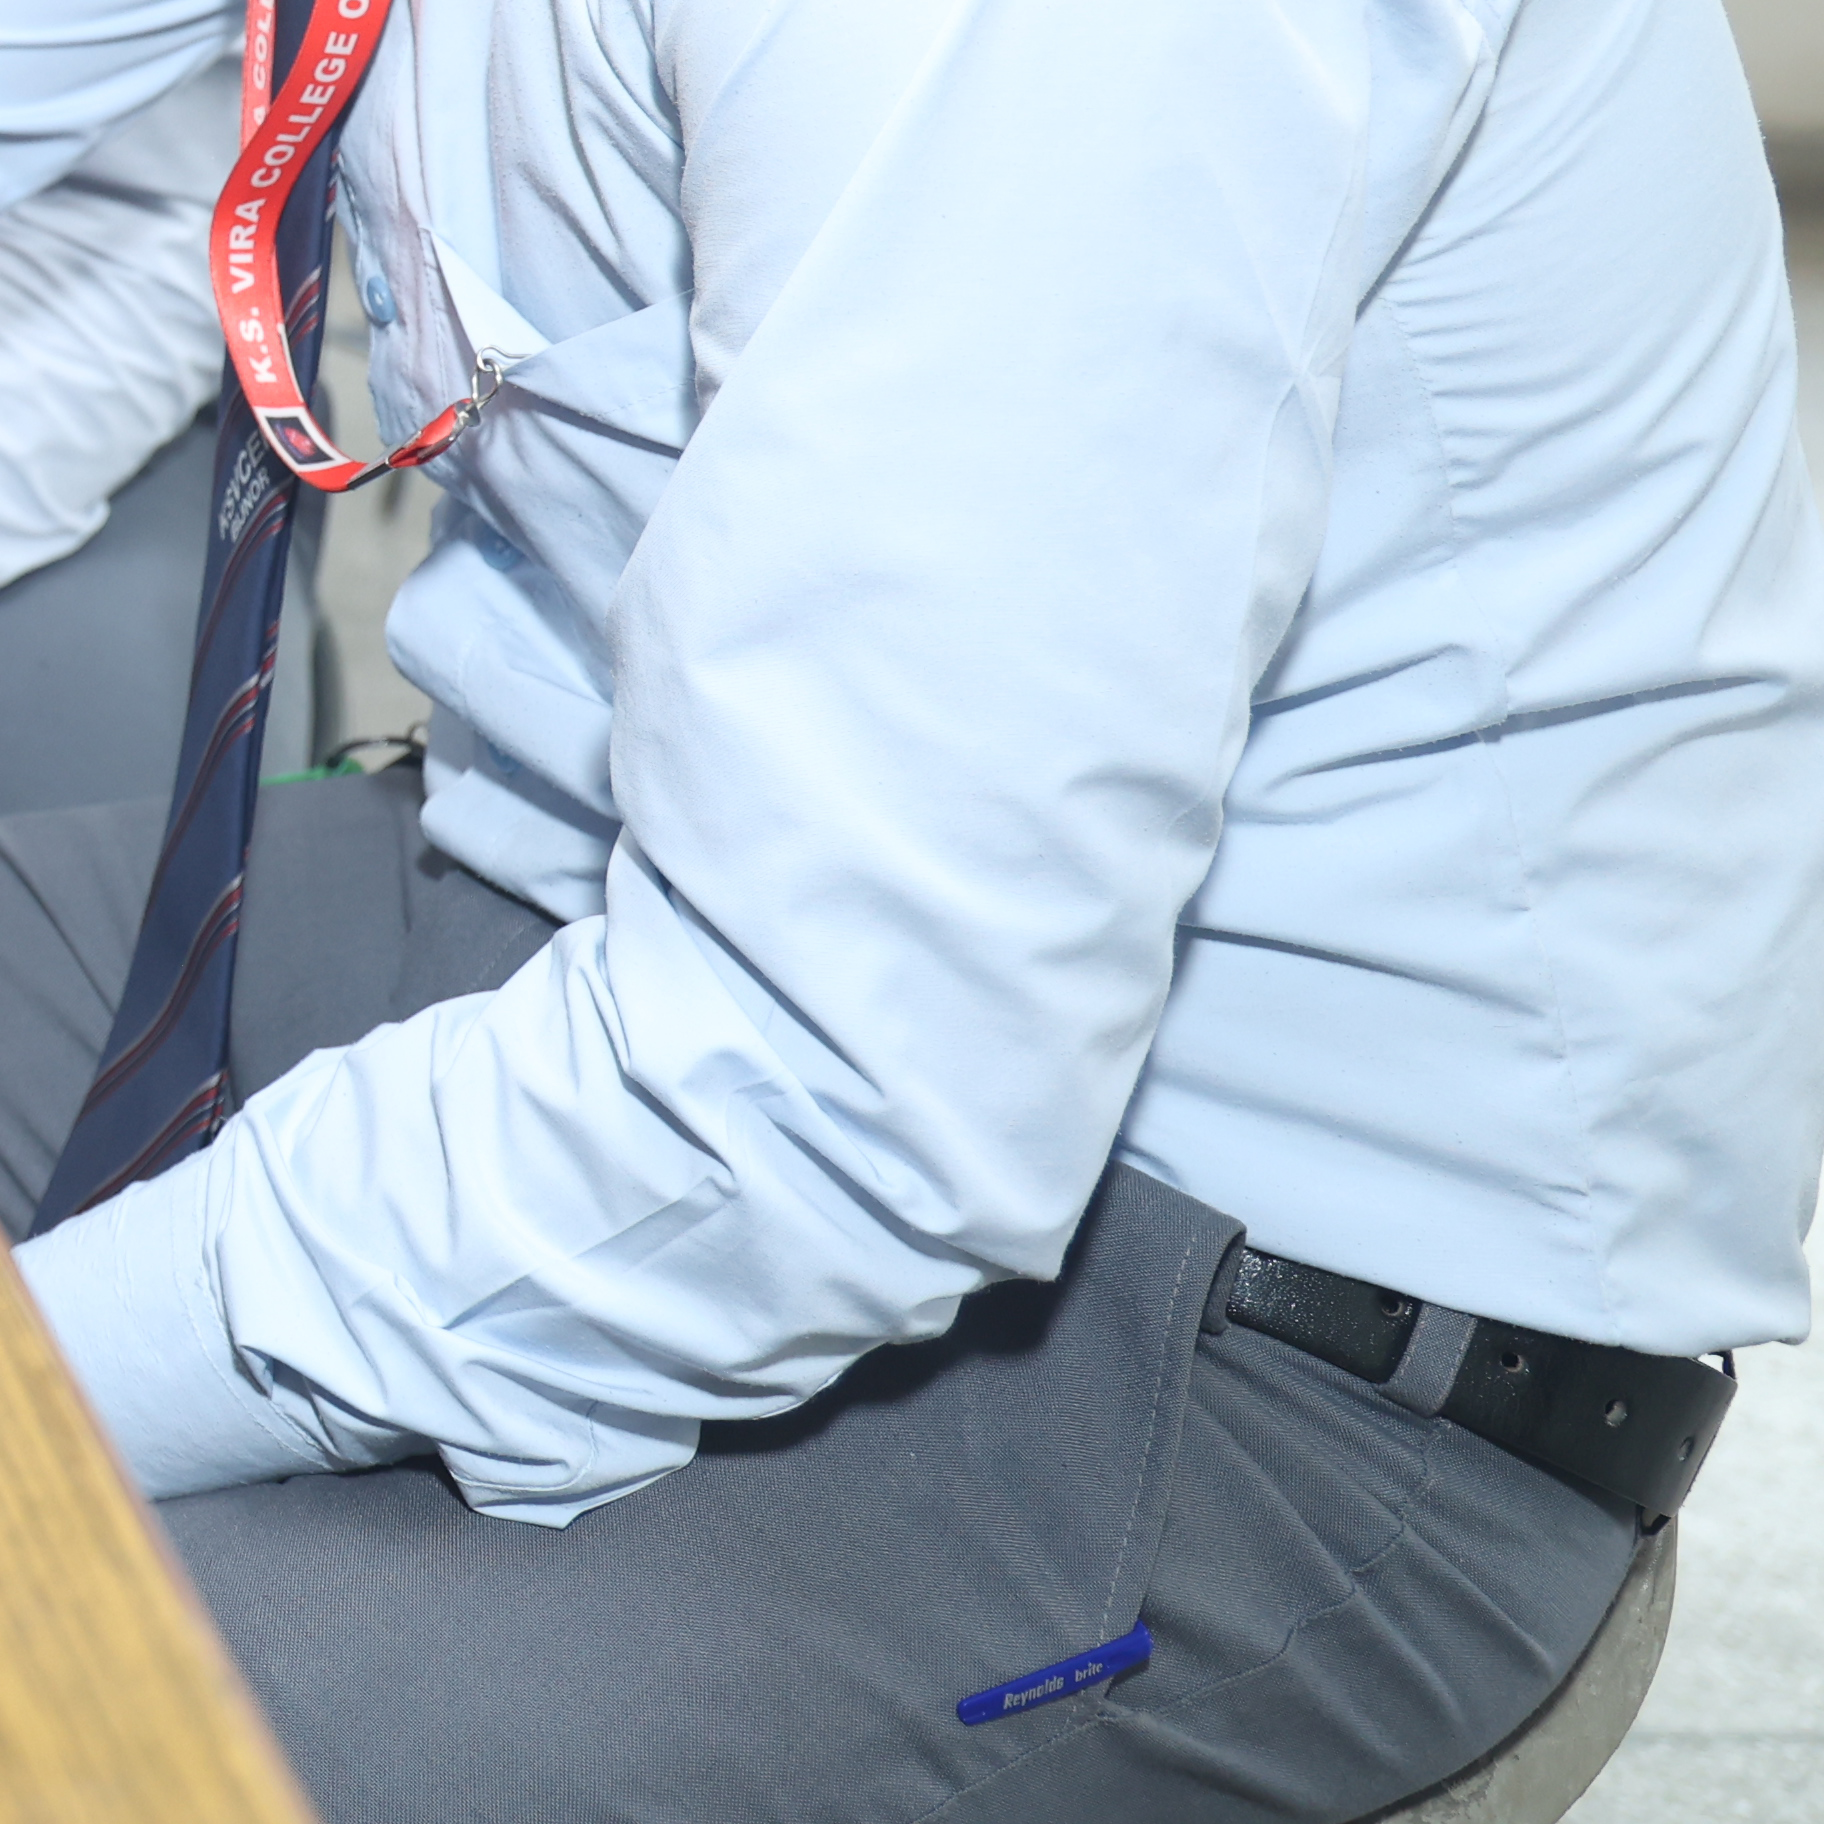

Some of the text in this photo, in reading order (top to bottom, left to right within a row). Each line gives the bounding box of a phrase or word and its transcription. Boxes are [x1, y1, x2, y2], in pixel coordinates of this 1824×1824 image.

[251, 31, 358, 188] COLLEGE
[228, 197, 265, 294] VIRA
[240, 306, 278, 385] K.S.
[218, 429, 271, 541] KSVCE
[1003, 1675, 1065, 1710] Reynolds
